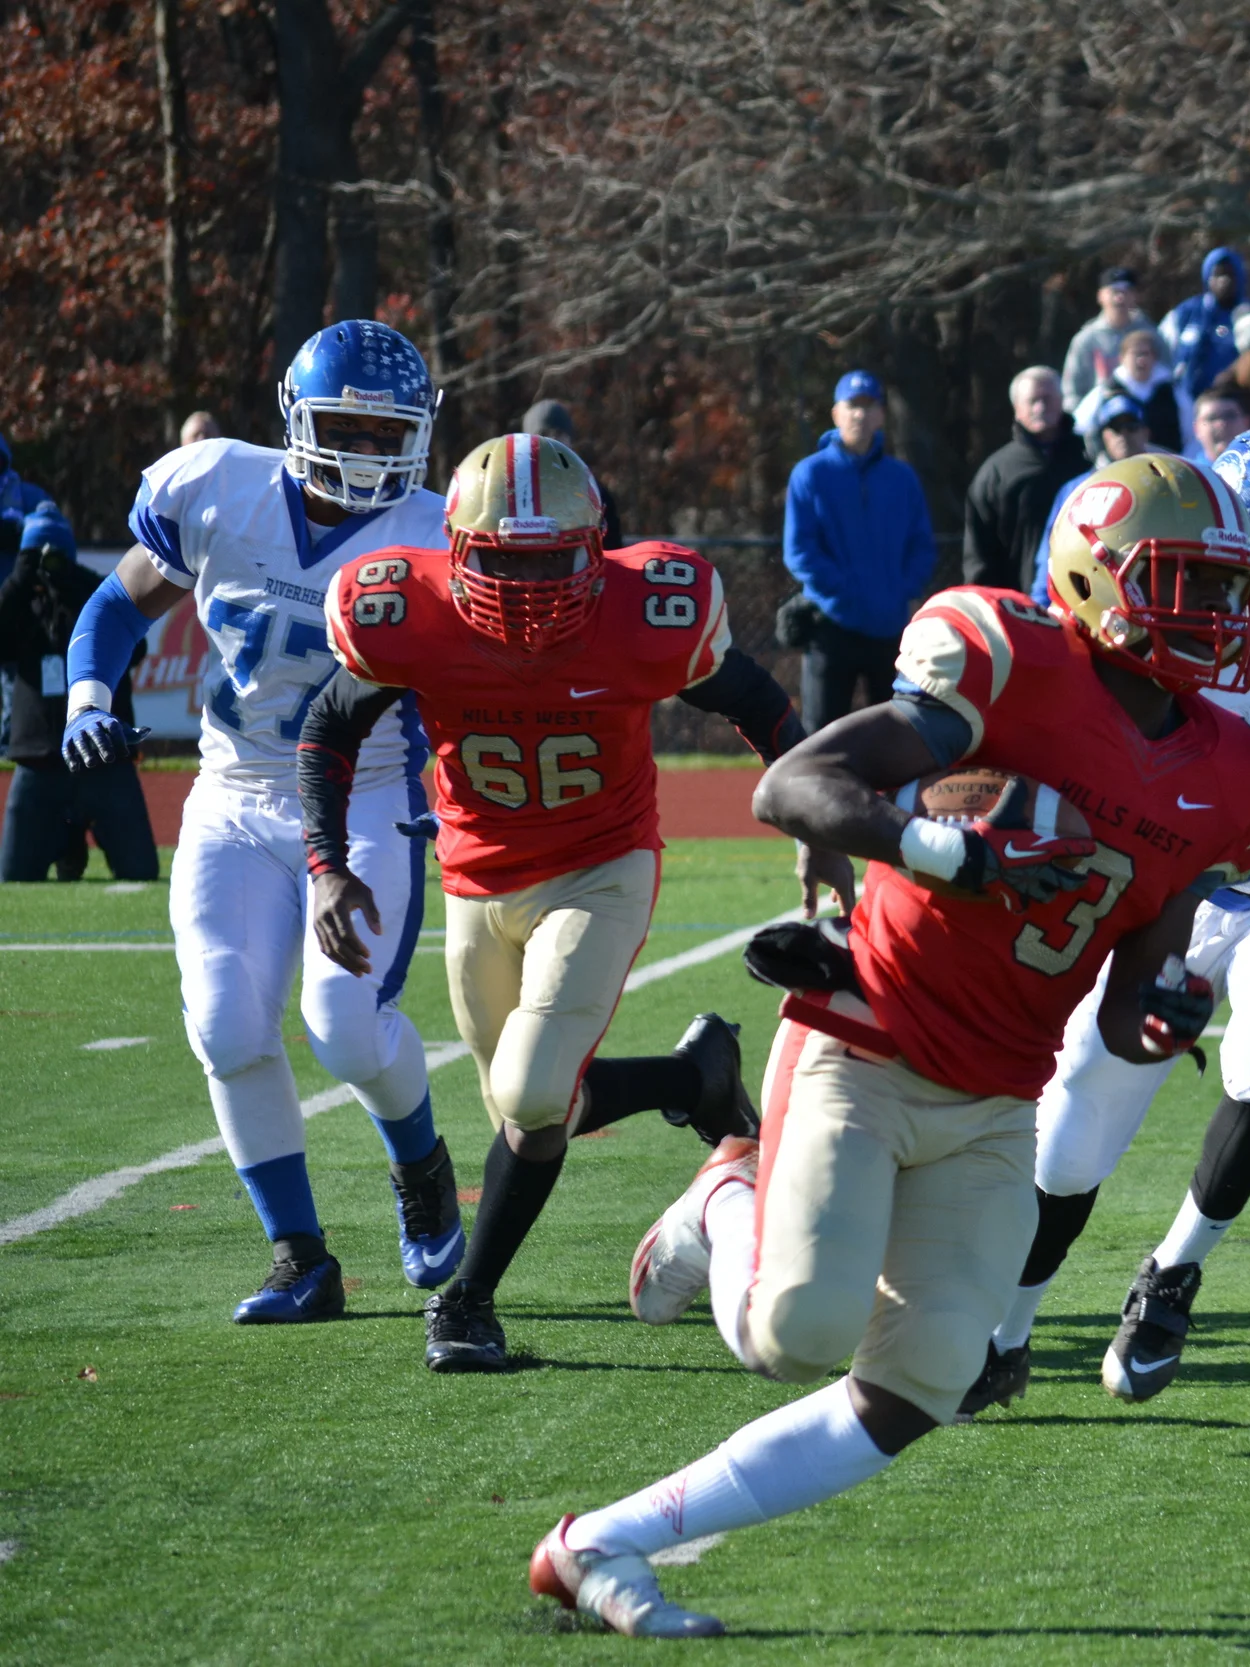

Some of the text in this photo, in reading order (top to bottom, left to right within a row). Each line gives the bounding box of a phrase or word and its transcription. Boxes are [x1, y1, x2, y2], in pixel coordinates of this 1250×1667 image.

[264, 577, 326, 608] RIVERHEA
[204, 594, 342, 742] 77
[462, 709, 598, 726] HILLS WEST
[460, 732, 604, 812] 66
[1057, 776, 1193, 858] HILLS WEST
[1013, 837, 1136, 980] 3
